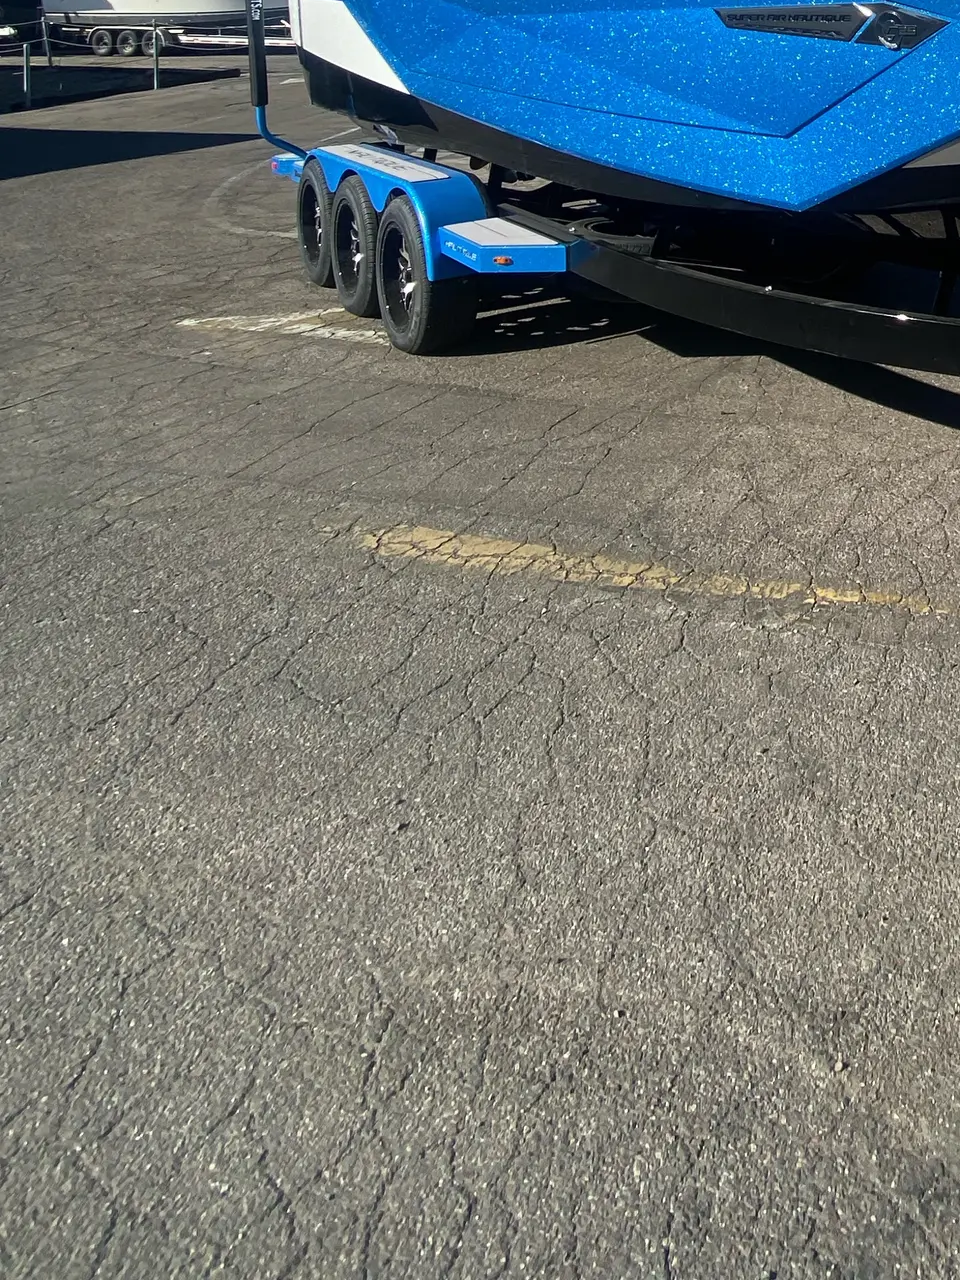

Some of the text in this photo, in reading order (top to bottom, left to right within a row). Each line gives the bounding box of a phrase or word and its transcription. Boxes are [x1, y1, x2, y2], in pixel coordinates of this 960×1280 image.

[727, 13, 852, 23] SUPER AIR NAUTIQUE
